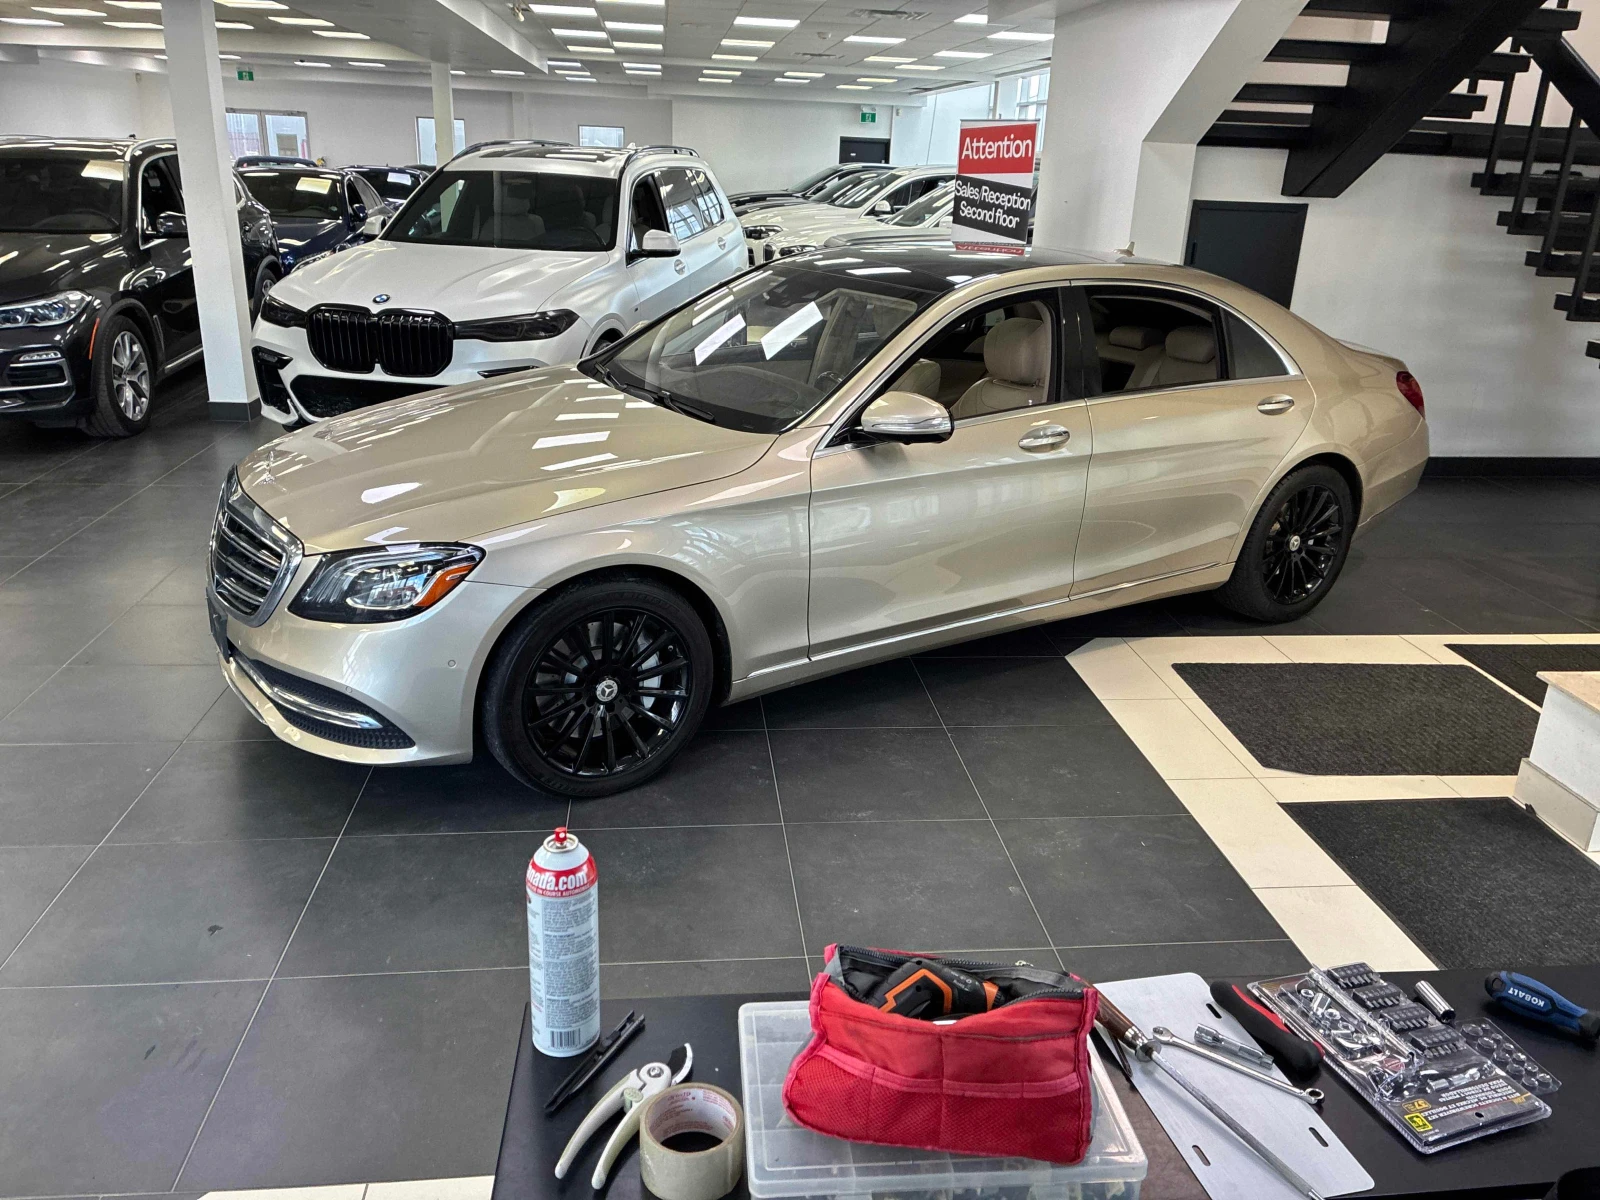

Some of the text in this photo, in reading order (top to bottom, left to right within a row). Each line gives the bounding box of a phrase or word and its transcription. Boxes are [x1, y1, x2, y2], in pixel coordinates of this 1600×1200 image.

[961, 133, 1032, 160] Attention
[960, 201, 1020, 229] Second floor
[1507, 987, 1545, 1008] KOBALT
